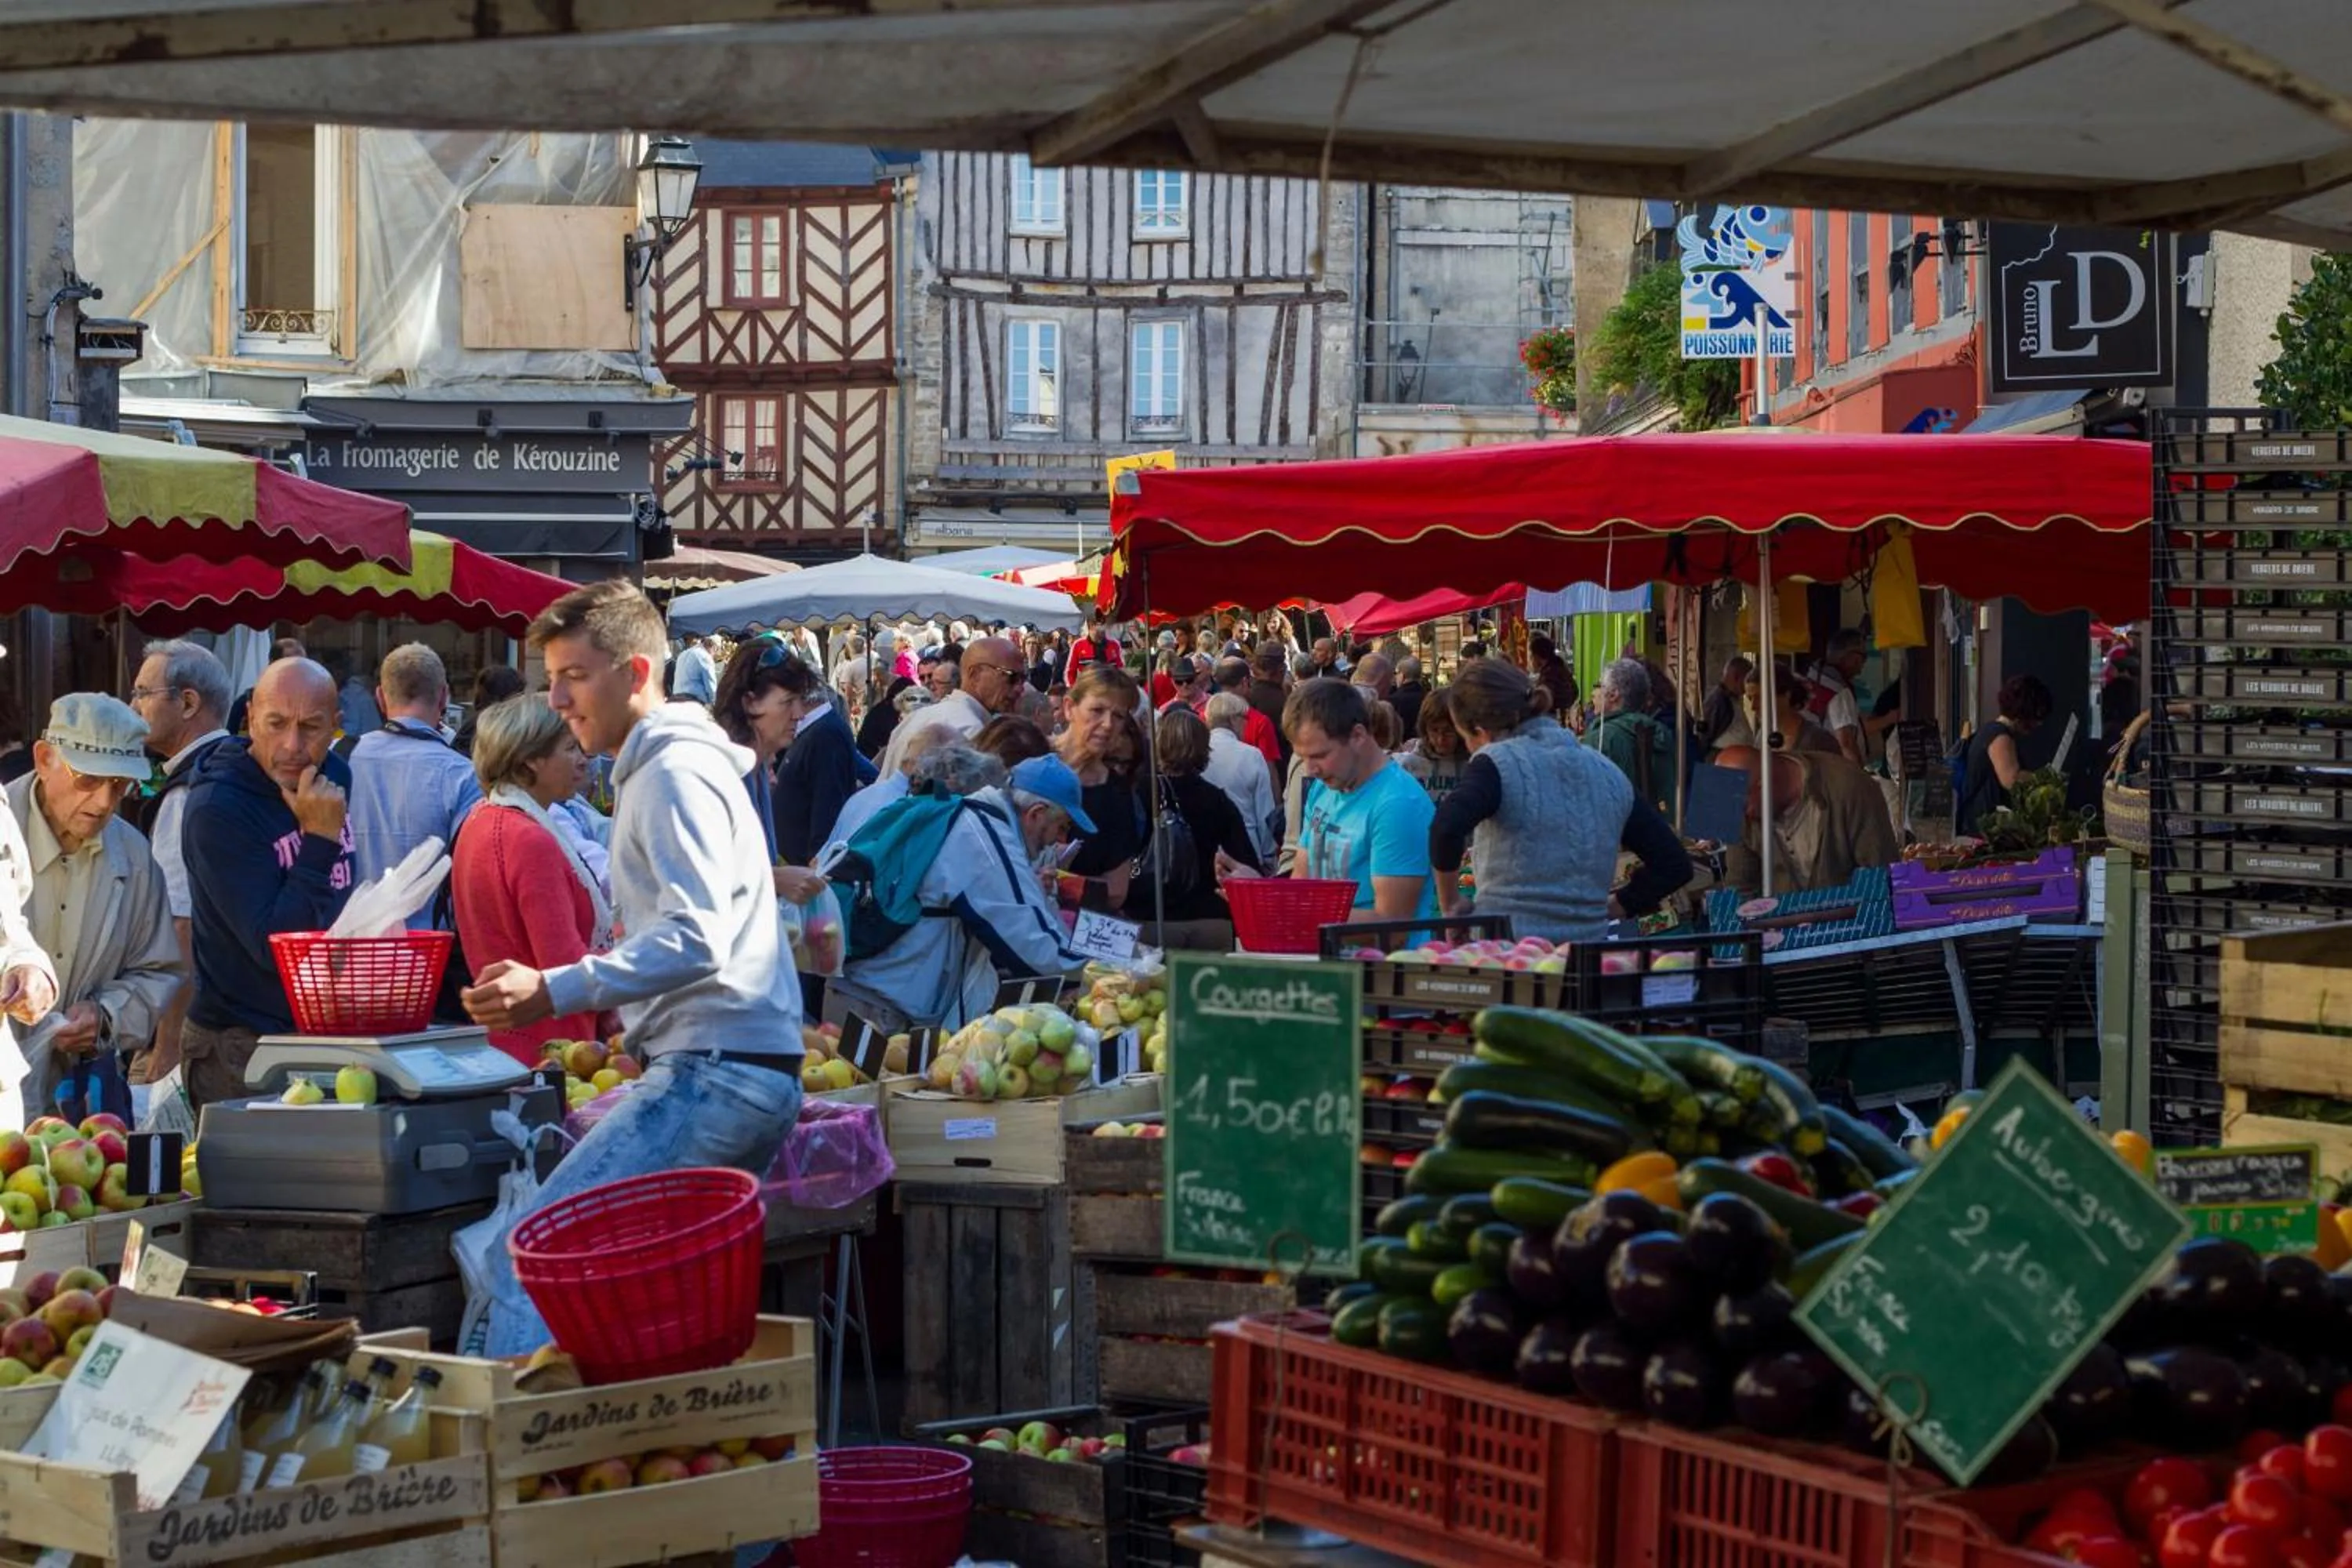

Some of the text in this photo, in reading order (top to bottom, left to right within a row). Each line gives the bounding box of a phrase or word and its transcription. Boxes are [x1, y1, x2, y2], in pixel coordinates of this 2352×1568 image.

[1685, 332, 1794, 354] POISSONNRIE
[2019, 286, 2038, 353] Bruno
[305, 440, 621, 477] La Fromagerie de Kérouzine
[1189, 967, 1341, 1024] Courgettes
[521, 1399, 639, 1444] Jardins
[648, 1392, 679, 1419] de
[684, 1378, 775, 1411] Brière
[147, 1496, 292, 1562] Jardins
[299, 1484, 340, 1525] de
[345, 1465, 459, 1517] Brière
